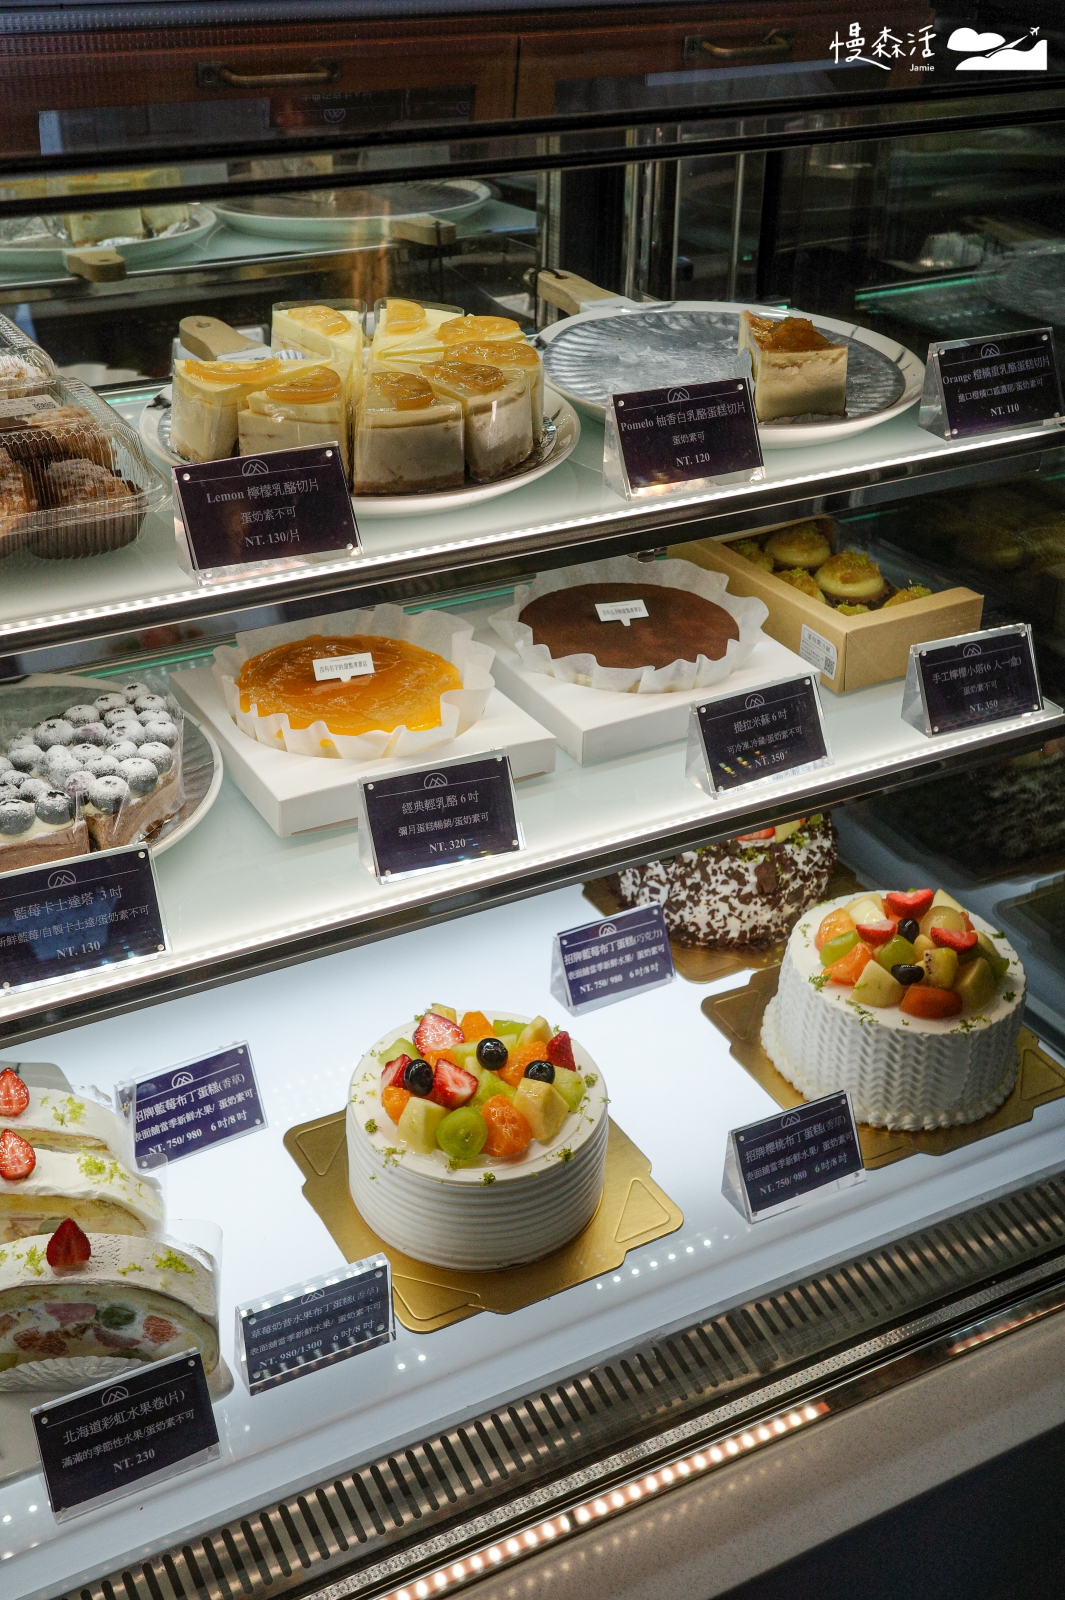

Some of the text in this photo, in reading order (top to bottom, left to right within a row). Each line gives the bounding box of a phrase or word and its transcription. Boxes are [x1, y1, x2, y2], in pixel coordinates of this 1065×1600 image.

[942, 373, 972, 385] Orange
[620, 401, 746, 432] Pomelo 柚香白乳酪蛋糕切片
[990, 403, 1020, 416] NT. 110
[672, 431, 705, 446] 蛋奶素可
[676, 452, 710, 467] NT. 120
[206, 478, 319, 504] Lemon 檸檬乳酪切片
[240, 506, 296, 524] 蛋奶素不可
[245, 528, 300, 548] NT. 130/片
[963, 680, 998, 696] 蛋奶素不可
[970, 700, 998, 714] NT. 350
[754, 751, 785, 768] NT. 350
[429, 838, 466, 854] NT. 320
[56, 940, 100, 960] NT. 130
[580, 984, 594, 994] NT.
[148, 1142, 166, 1154] NT.
[760, 1184, 774, 1196] NT.
[260, 1356, 278, 1369] NT.
[280, 1340, 322, 1361] 980/1300
[62, 1390, 185, 1445] 北海道彩虹水果卷(片)
[113, 1448, 155, 1473] NT. 230
